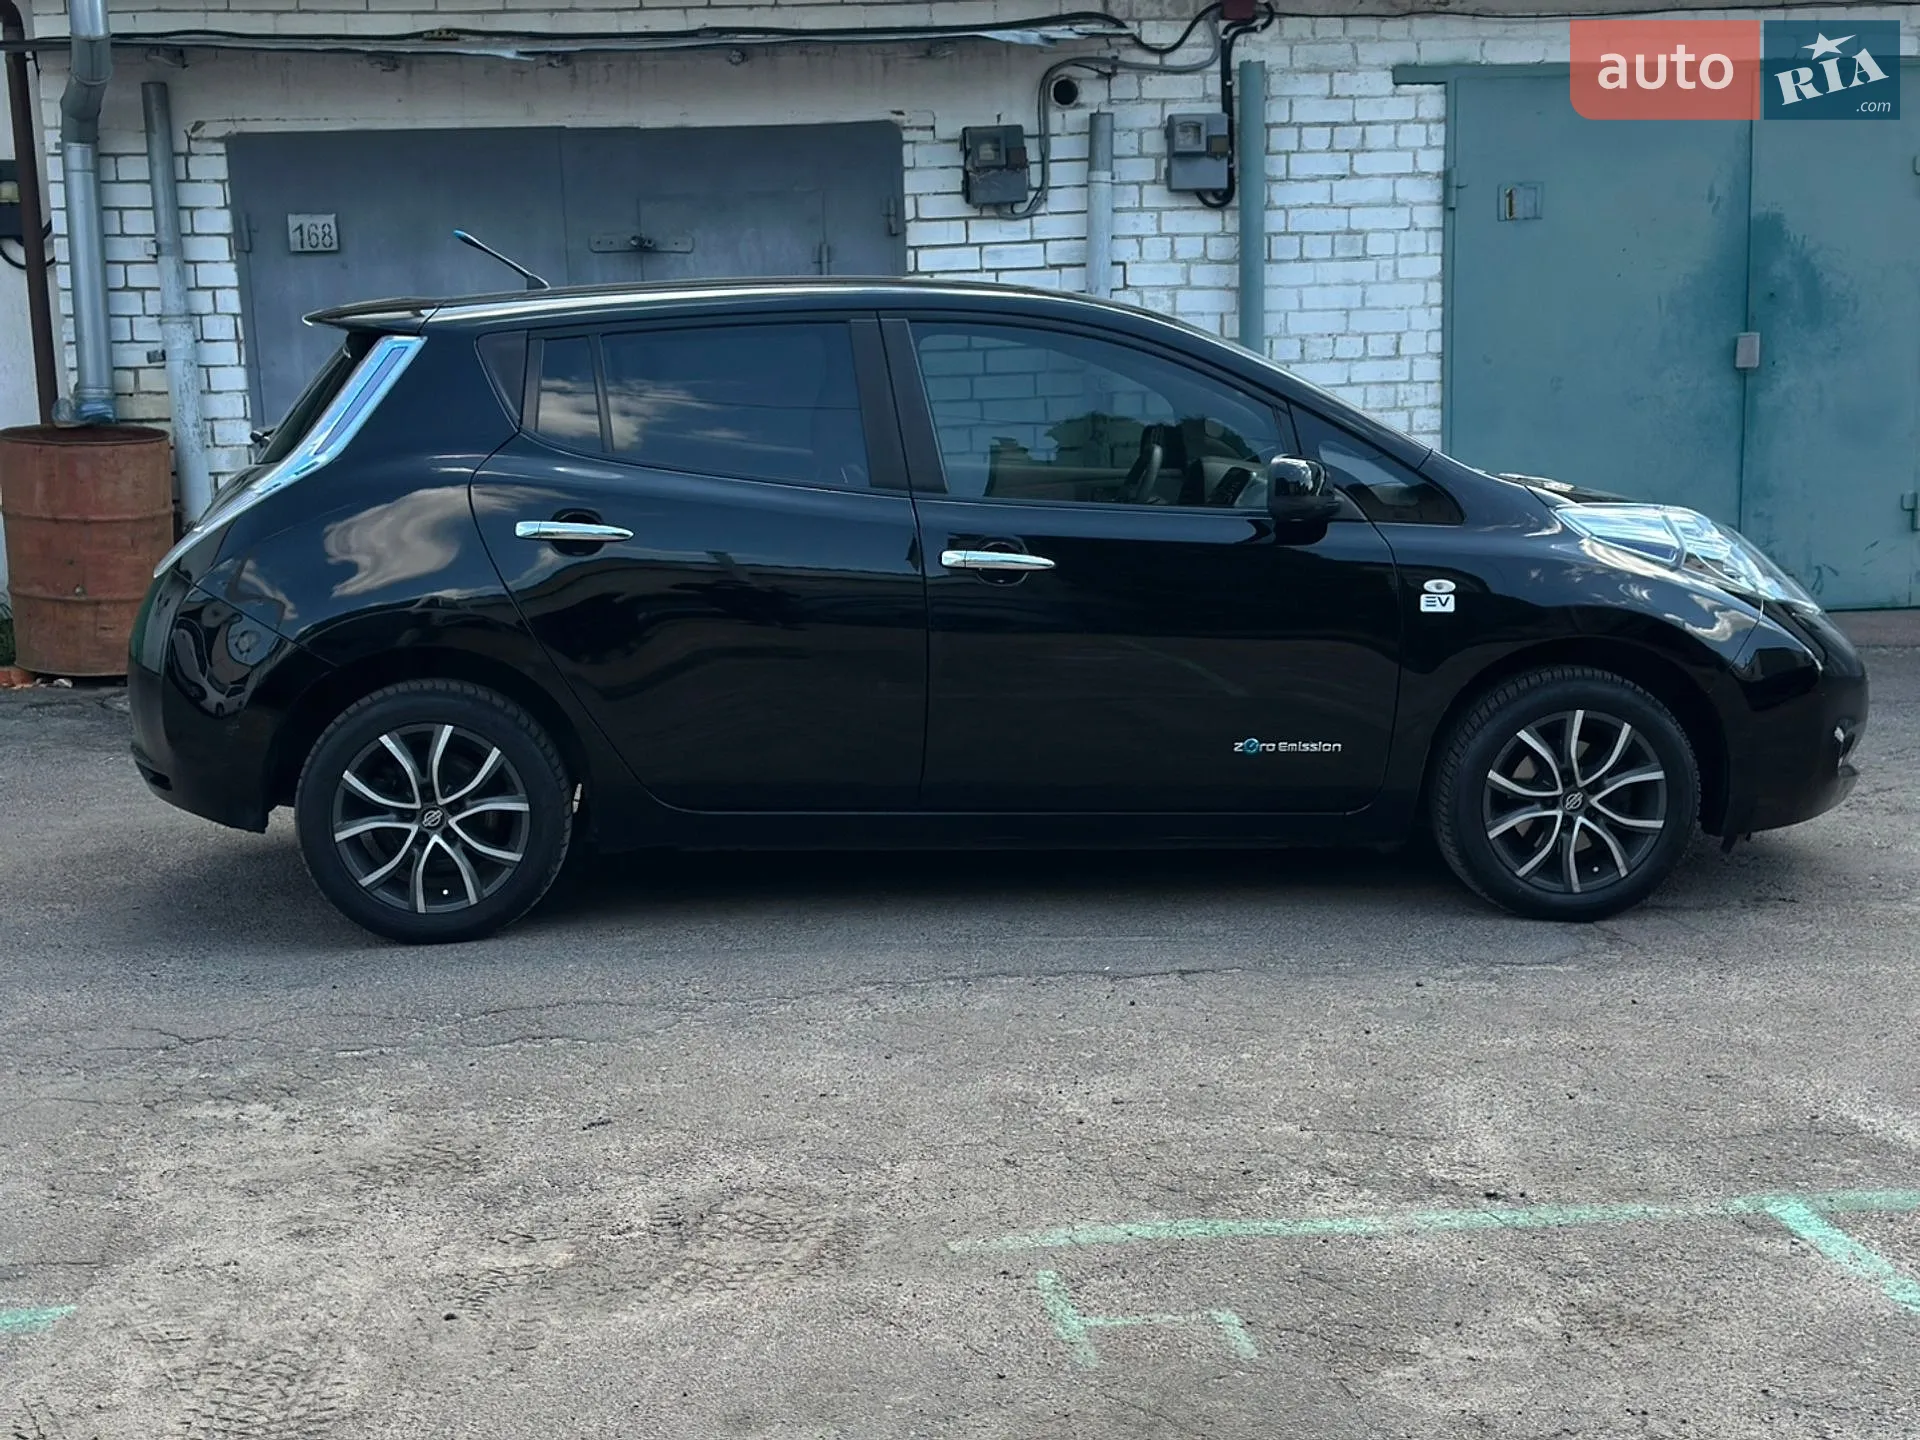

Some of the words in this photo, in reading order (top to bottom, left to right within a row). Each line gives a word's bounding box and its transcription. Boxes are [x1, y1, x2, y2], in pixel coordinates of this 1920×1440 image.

[292, 223, 333, 249] 168
[1425, 596, 1450, 607] EV
[1278, 741, 1342, 752] Emission
